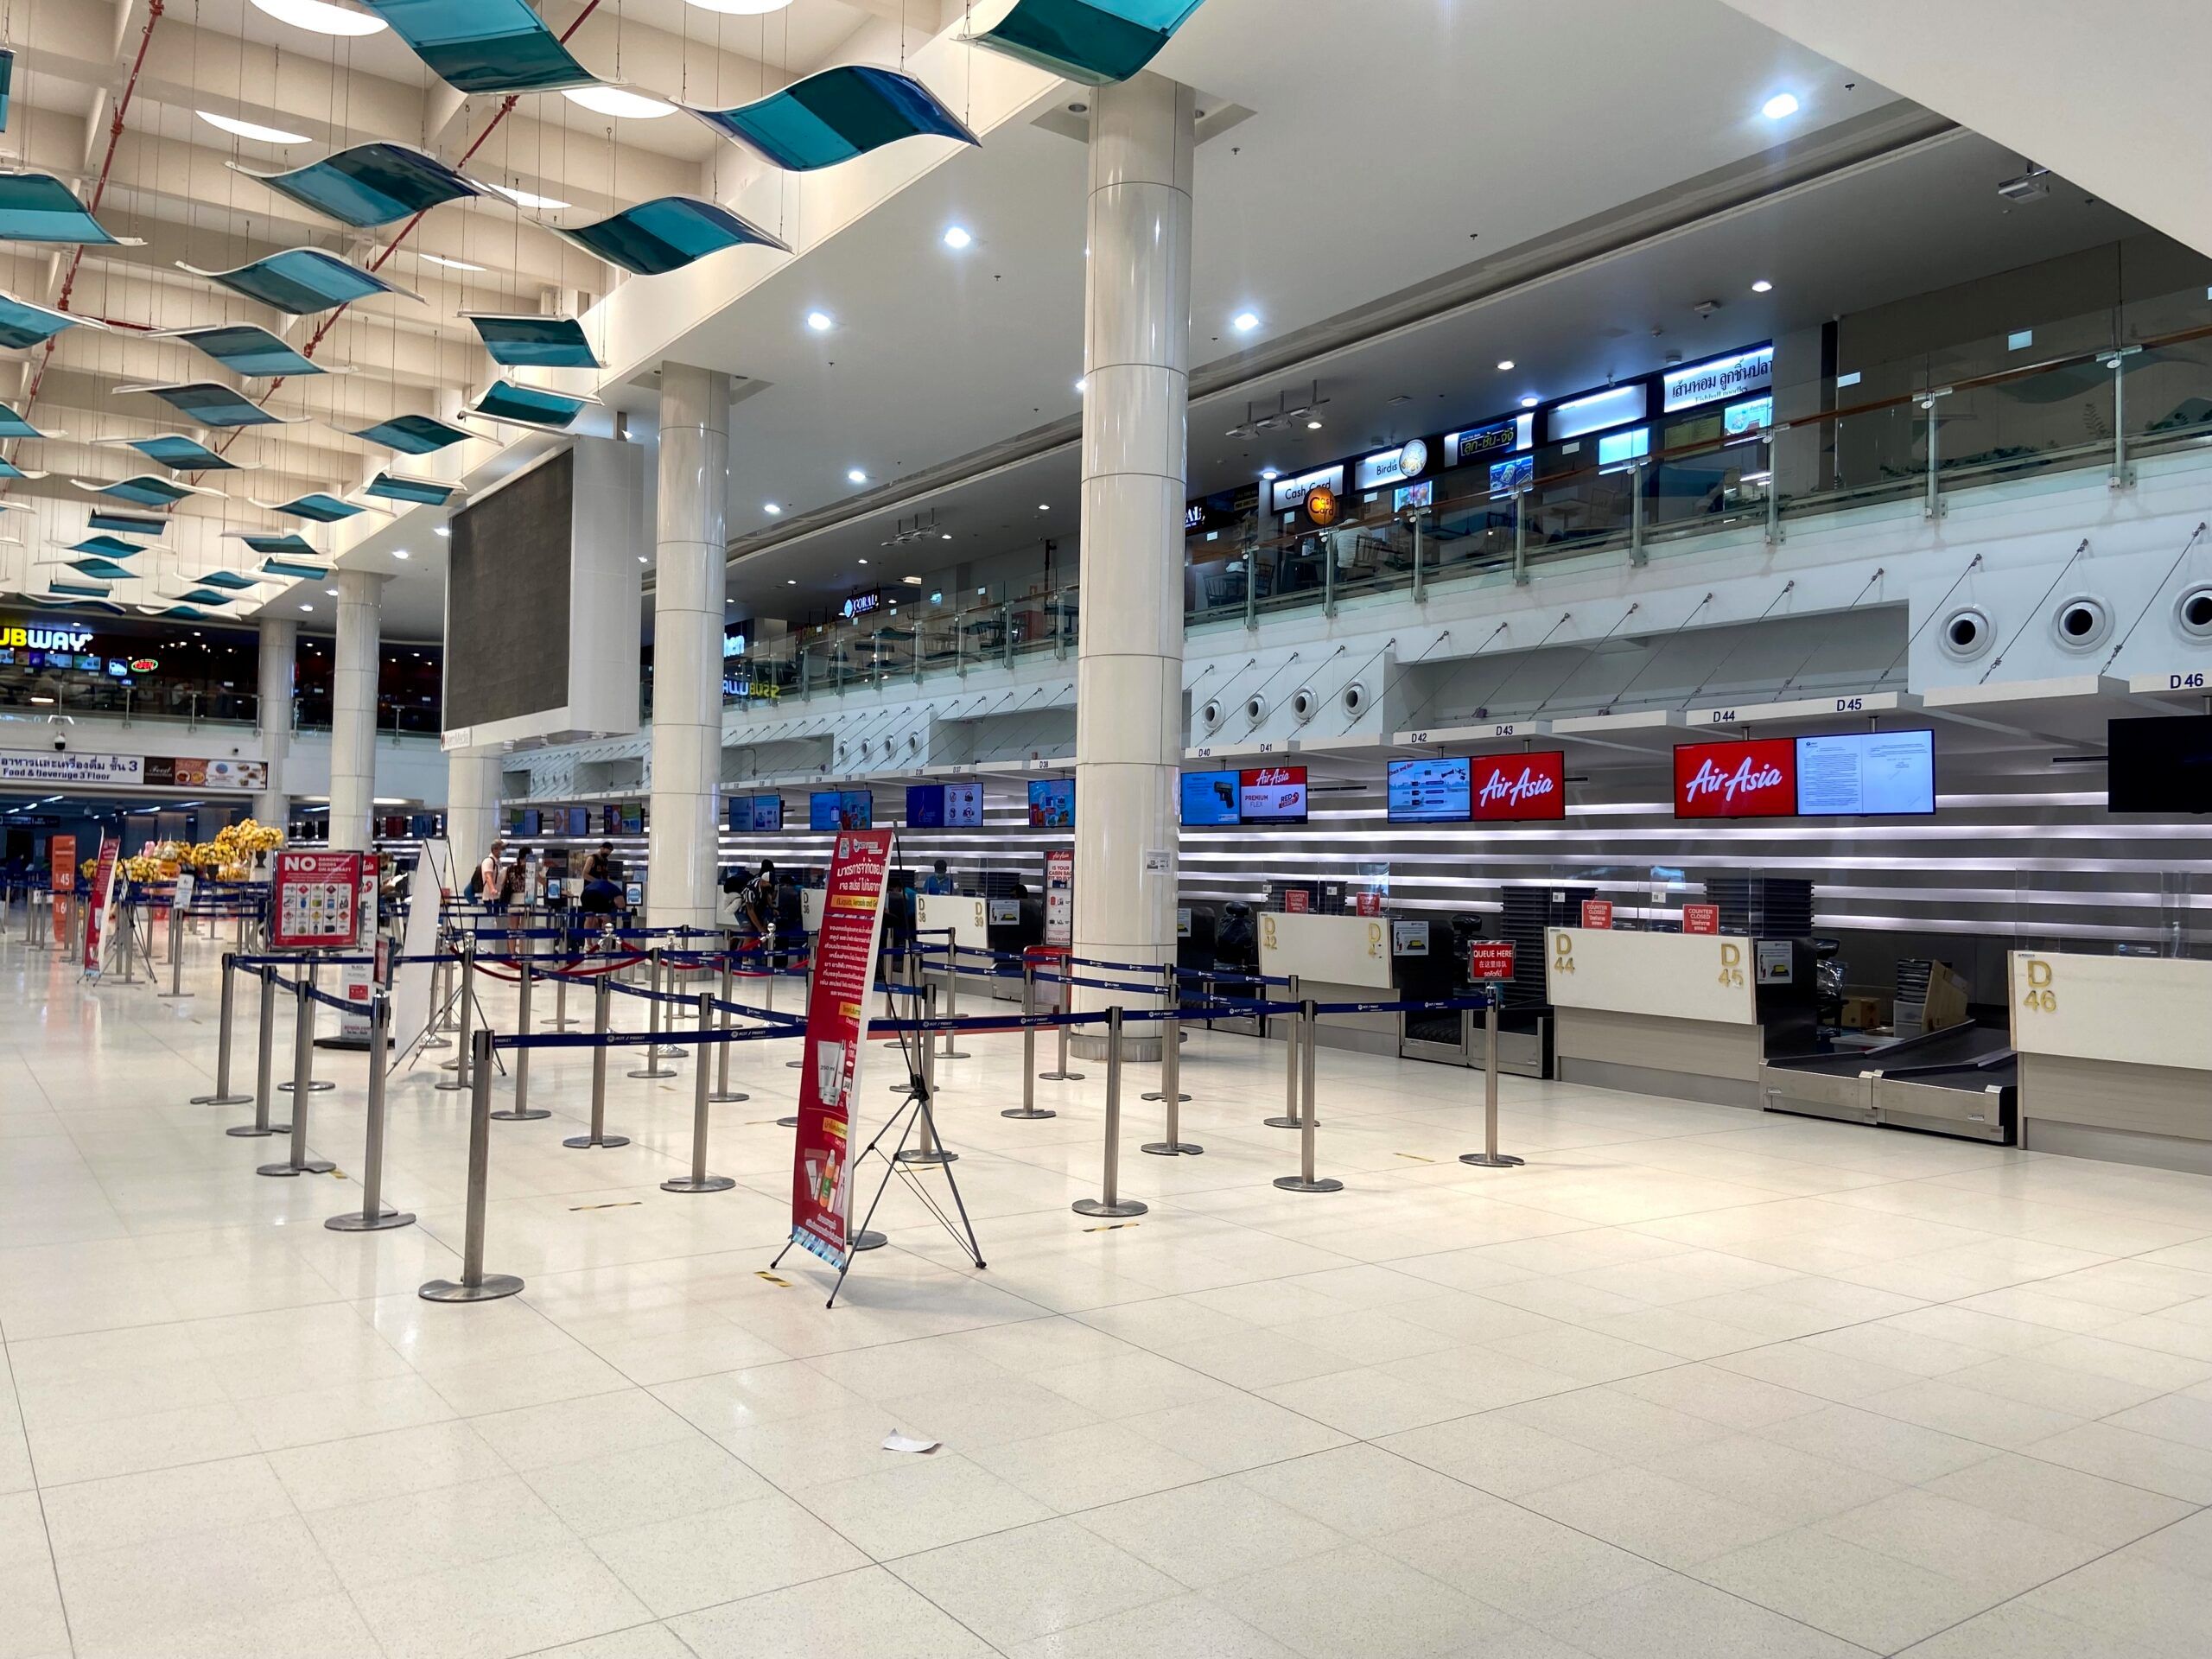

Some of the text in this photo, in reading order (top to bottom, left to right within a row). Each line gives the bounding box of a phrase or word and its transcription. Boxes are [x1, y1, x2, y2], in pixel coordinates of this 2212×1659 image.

[1672, 375, 1716, 397] เส้นหอม
[1285, 484, 1306, 499] Cash
[3, 767, 25, 777] Food
[87, 772, 111, 781] Floor
[129, 760, 138, 772] 3
[1281, 793, 1292, 802] RED
[284, 856, 316, 872] NO
[918, 898, 925, 911] D
[975, 901, 983, 915] D
[1264, 917, 1275, 936] D
[1368, 922, 1381, 943] D
[1555, 933, 1572, 955] D
[1473, 950, 1495, 958] QUEUE
[1721, 944, 1740, 967] D
[1554, 957, 1575, 975] 44
[2027, 960, 2052, 988] D
[1718, 968, 1744, 988] 45
[2023, 989, 2057, 1013] 46
